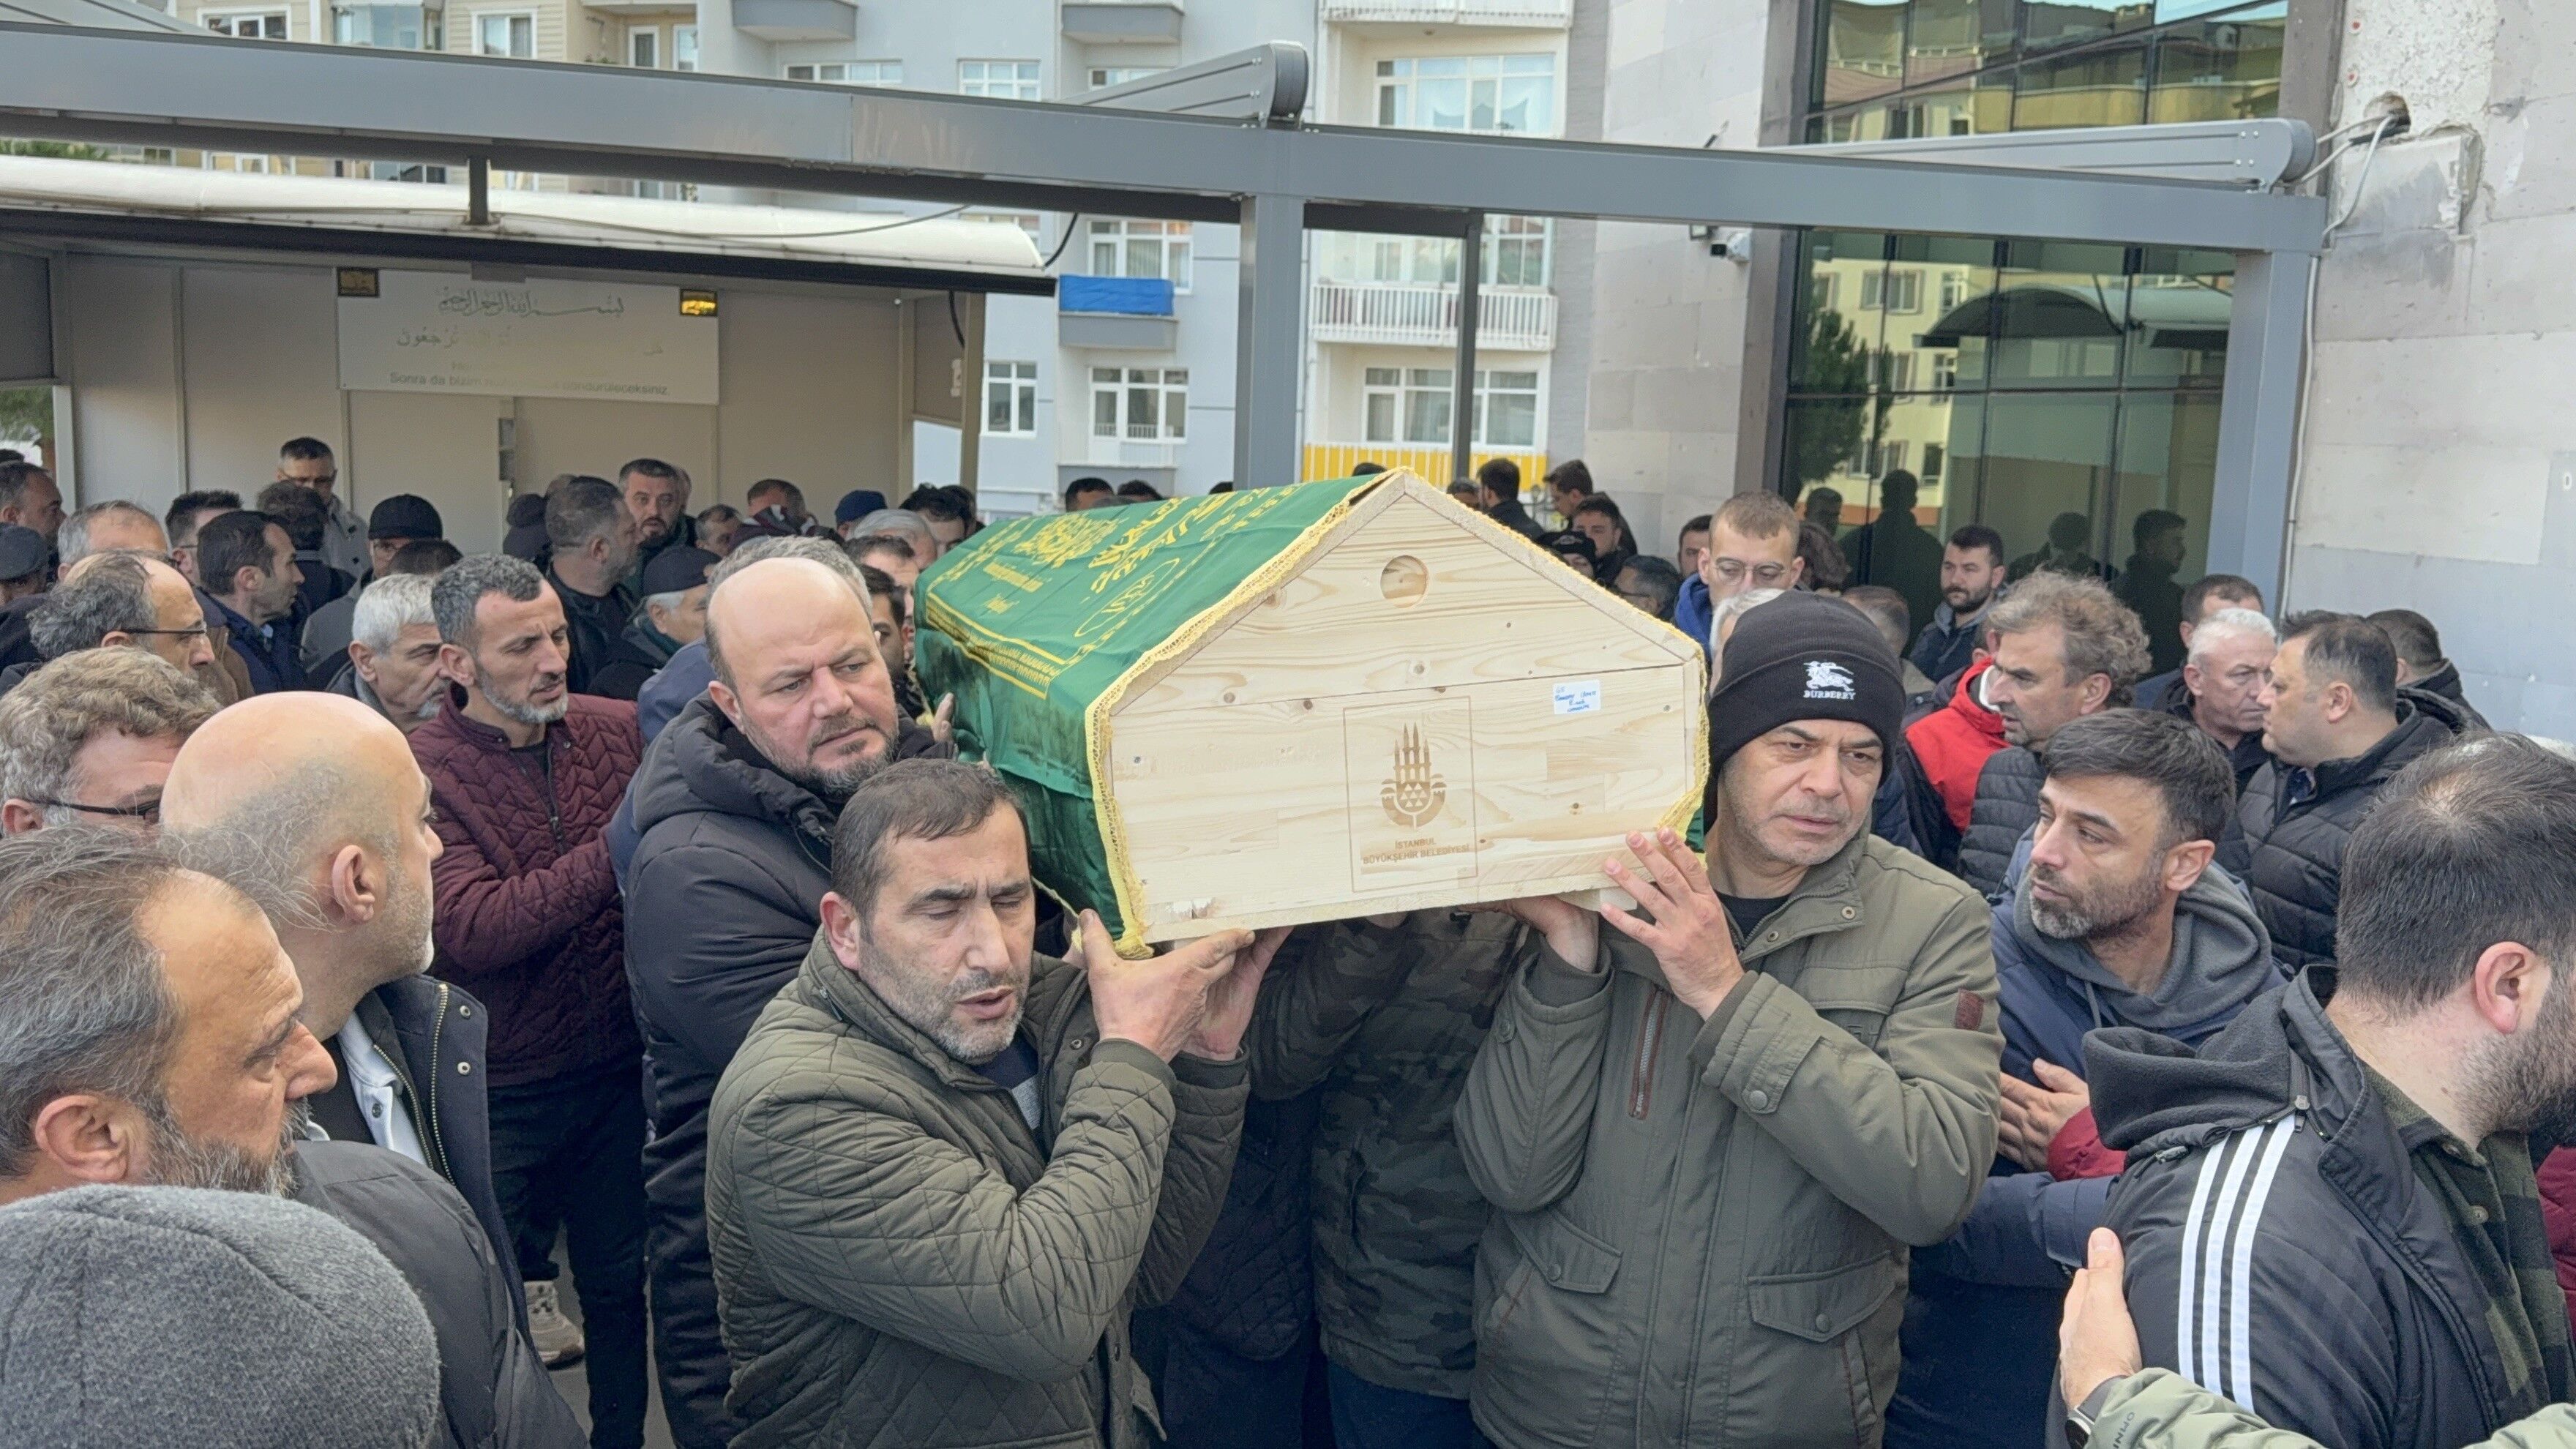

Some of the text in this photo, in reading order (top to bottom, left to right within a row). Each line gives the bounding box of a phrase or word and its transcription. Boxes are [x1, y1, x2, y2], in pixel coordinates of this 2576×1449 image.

[390, 372, 426, 384] Sonra
[430, 375, 446, 386] da
[1803, 690, 1856, 700] BURBERRY
[1395, 838, 1437, 850] İSTANBUL
[1363, 844, 1469, 865] BÜYÜKŞEHİR BELEDİYESİ
